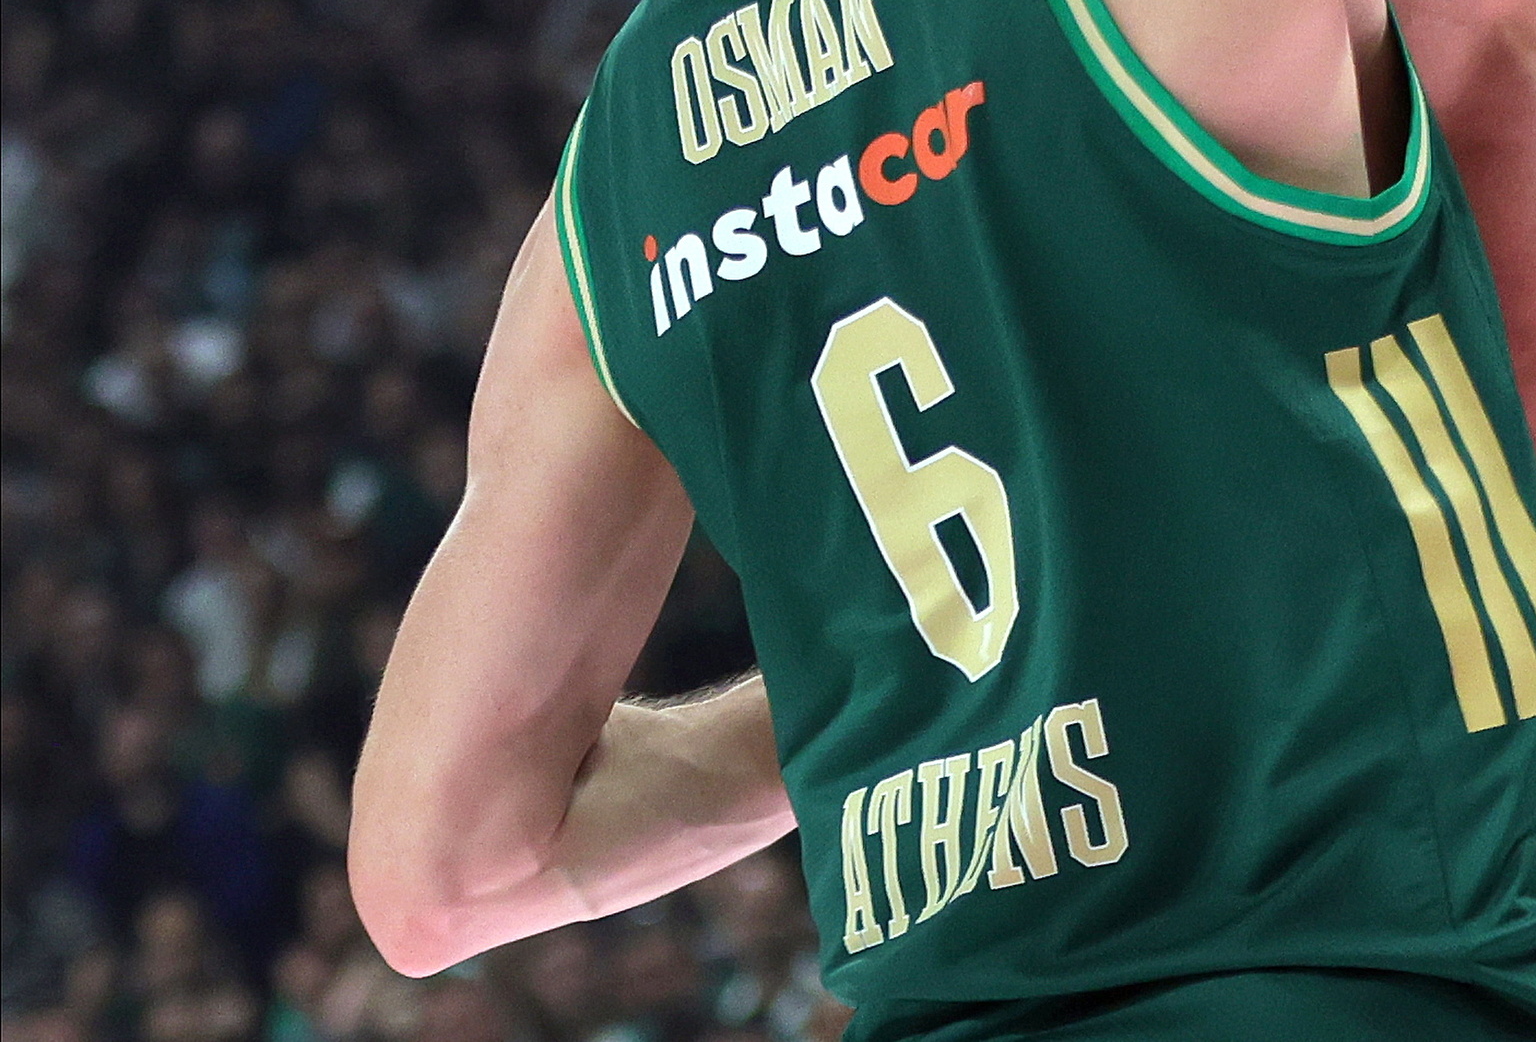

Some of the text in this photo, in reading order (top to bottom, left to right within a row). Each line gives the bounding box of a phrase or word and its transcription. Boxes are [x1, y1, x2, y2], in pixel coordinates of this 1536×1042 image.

[643, 80, 985, 338] instacar
[811, 296, 1019, 683] 6
[841, 698, 1129, 955] ATHENS
